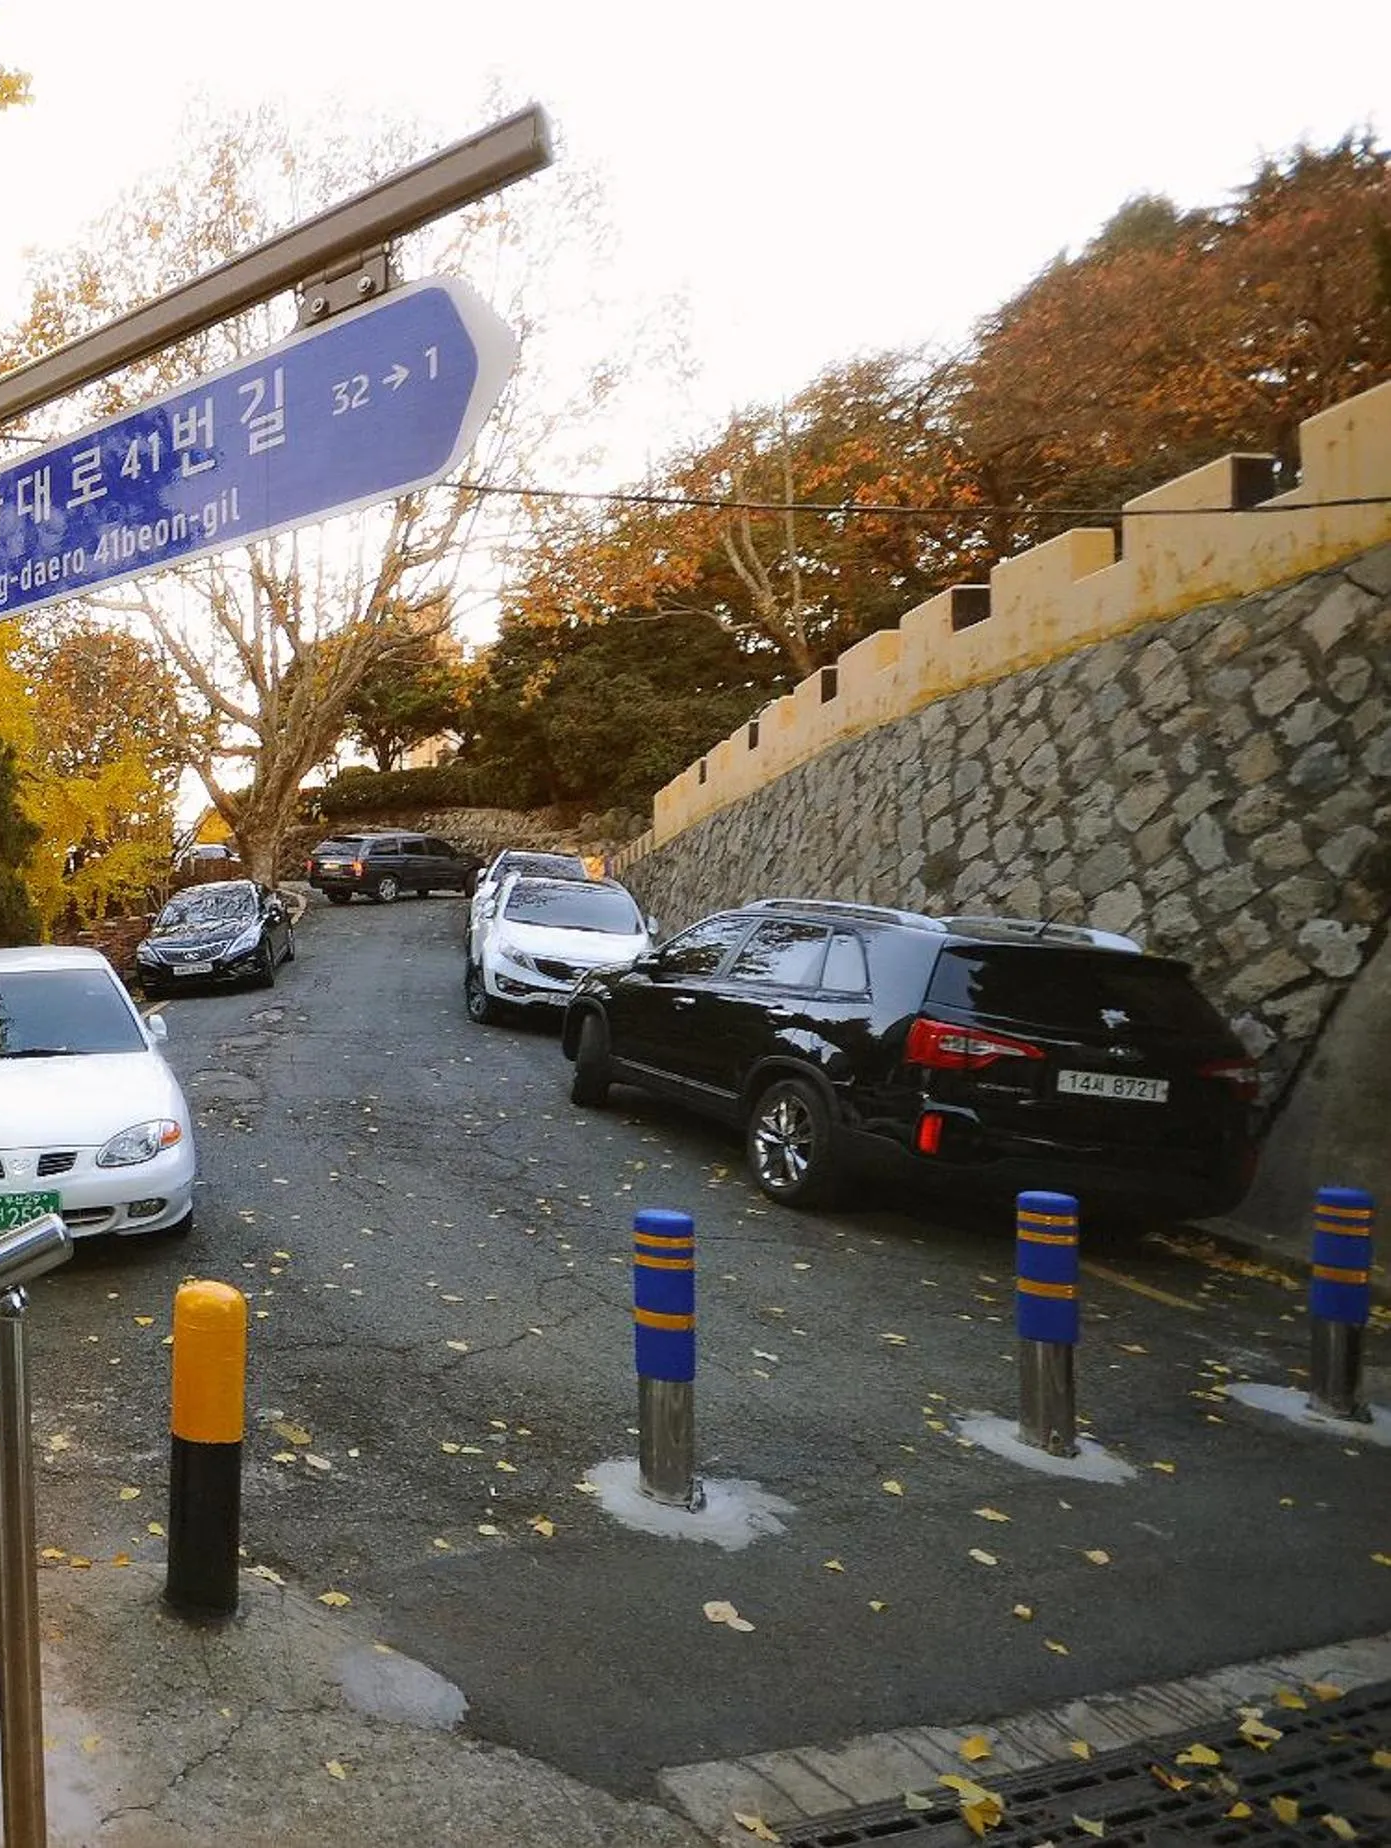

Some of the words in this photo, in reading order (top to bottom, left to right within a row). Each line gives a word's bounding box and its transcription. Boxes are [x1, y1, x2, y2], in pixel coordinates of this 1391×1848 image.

[332, 374, 371, 416] 32
[425, 346, 439, 380] 1
[93, 486, 241, 565] 41beon-gil
[1113, 1077, 1158, 1099] 8721
